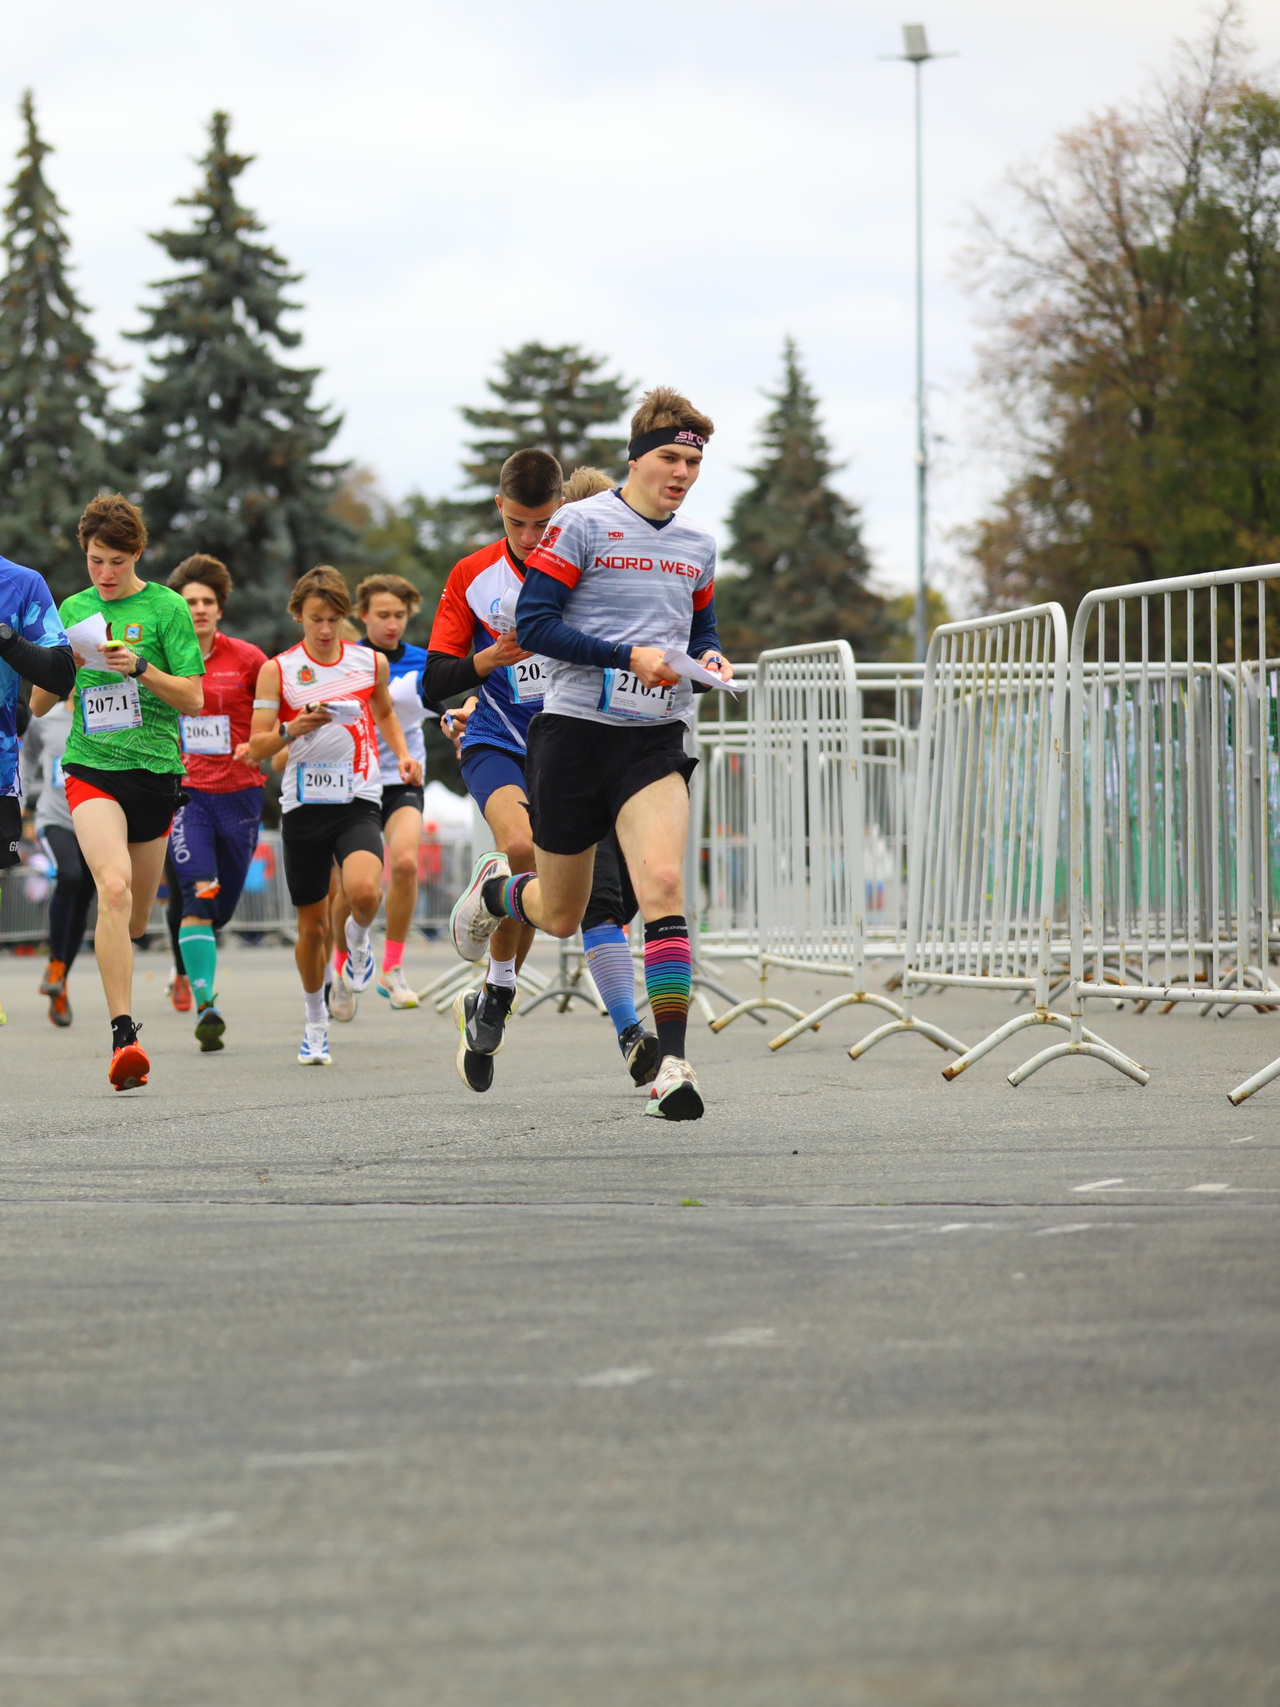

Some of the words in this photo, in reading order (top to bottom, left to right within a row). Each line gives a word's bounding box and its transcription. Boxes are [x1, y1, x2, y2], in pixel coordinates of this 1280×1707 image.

[676, 430, 706, 446] stro
[594, 556, 654, 571] NORD
[659, 559, 702, 581] WEST
[516, 662, 547, 683] 20
[87, 694, 129, 715] 207.1
[186, 724, 221, 739] 206.1
[305, 773, 345, 788] 209.1
